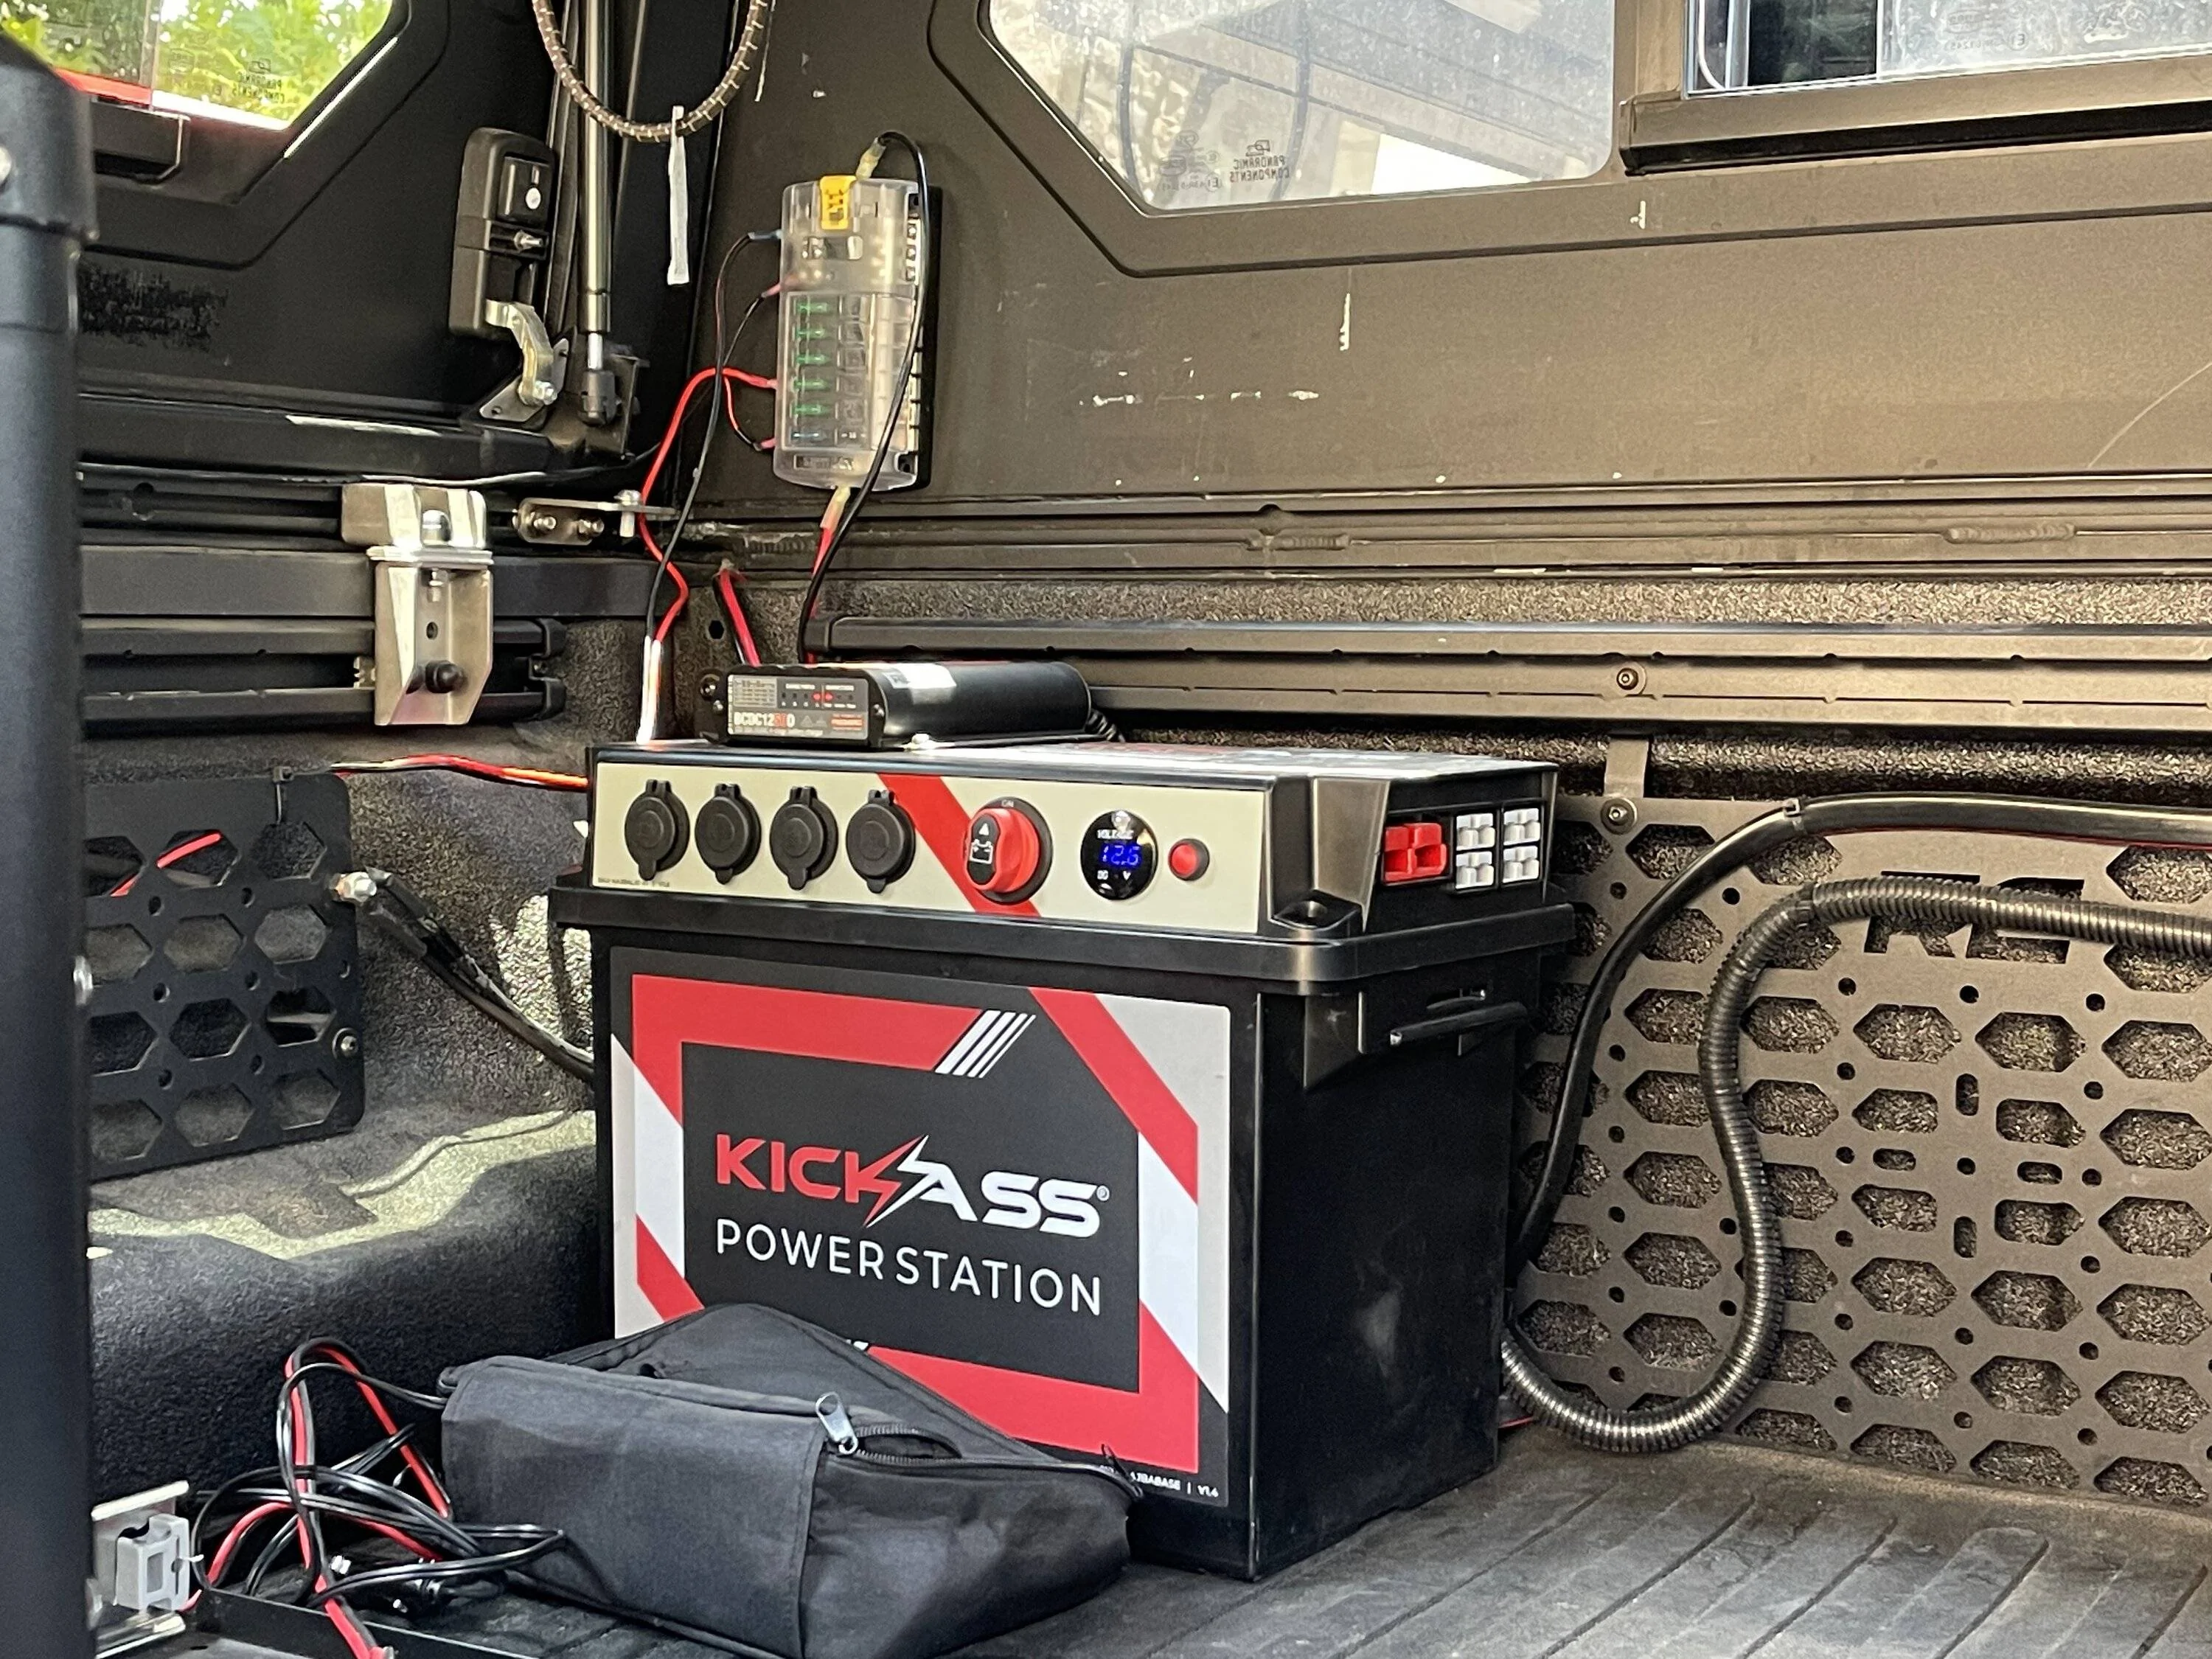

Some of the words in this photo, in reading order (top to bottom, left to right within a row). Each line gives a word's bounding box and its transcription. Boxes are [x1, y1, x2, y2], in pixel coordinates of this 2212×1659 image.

[1102, 845, 1140, 866] 12.6
[717, 1218, 884, 1280] POWER
[895, 1246, 1100, 1316] STATION
